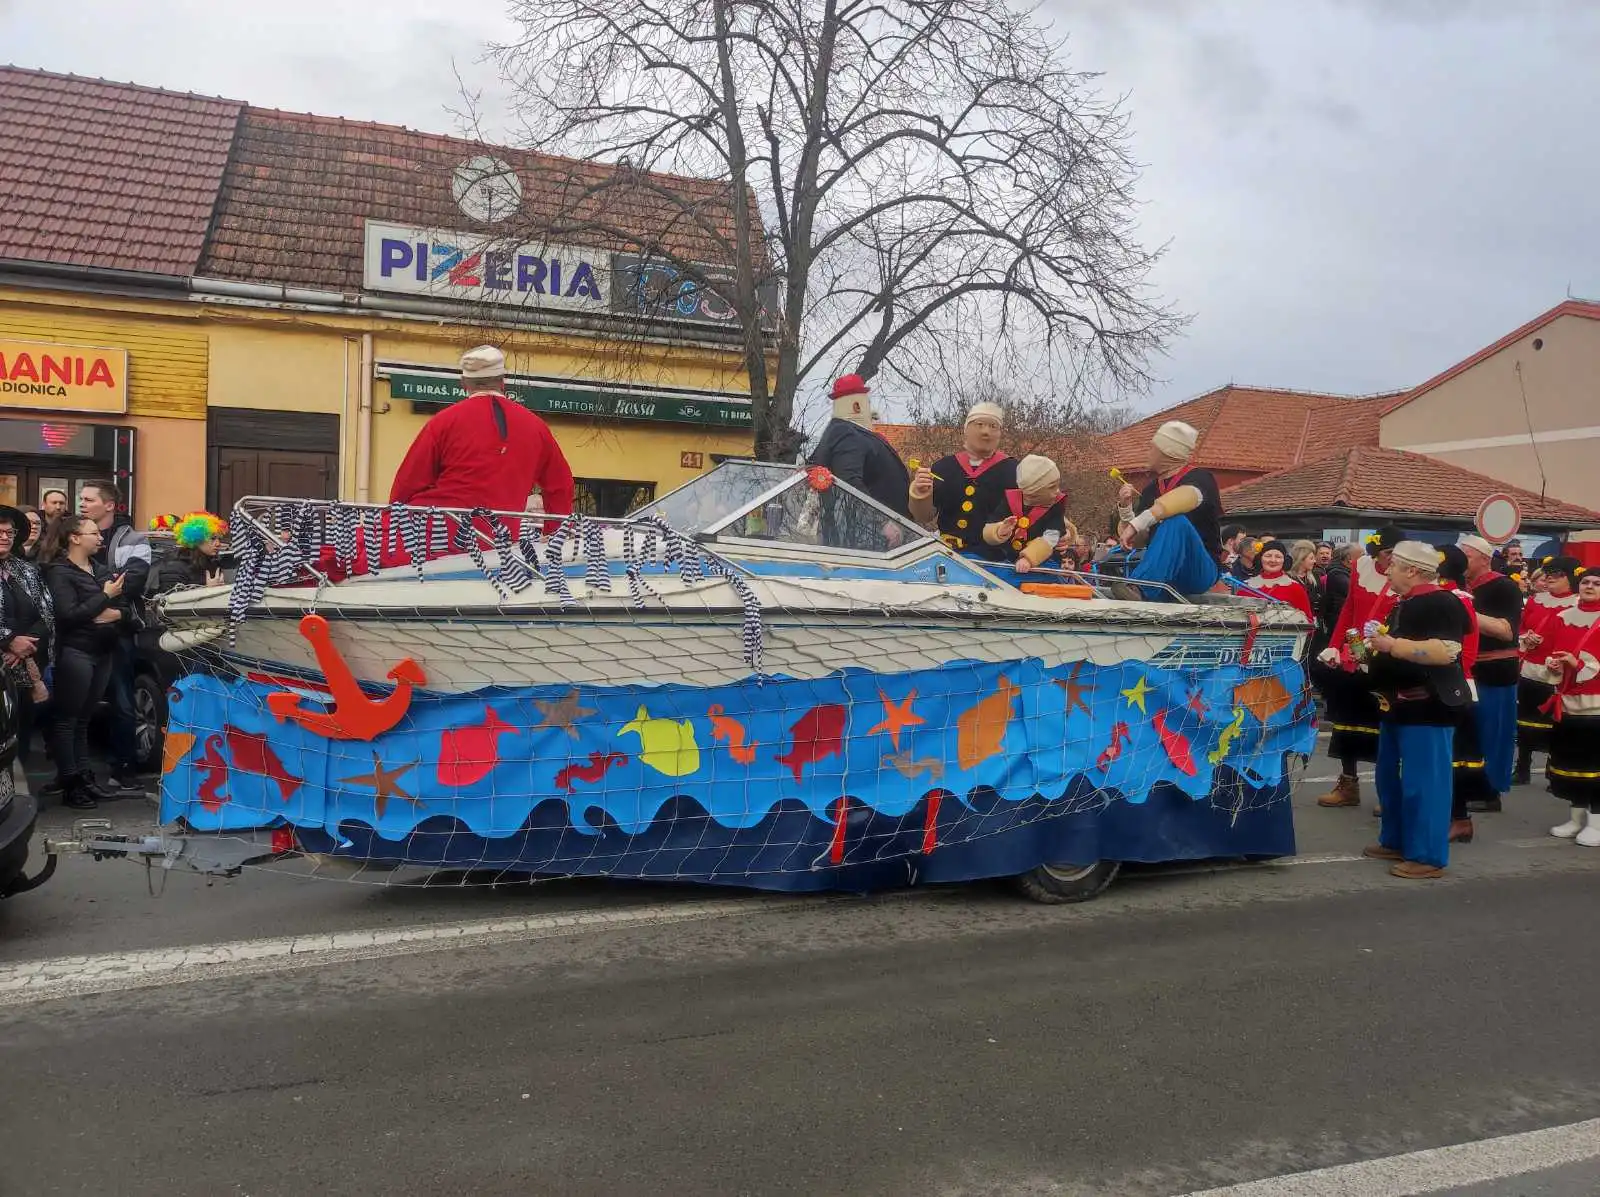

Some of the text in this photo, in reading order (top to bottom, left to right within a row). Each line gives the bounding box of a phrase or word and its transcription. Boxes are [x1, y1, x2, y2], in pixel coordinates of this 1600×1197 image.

[0, 381, 67, 397] DIONICA
[548, 399, 605, 413] TRATTORIA
[682, 453, 702, 467] 41
